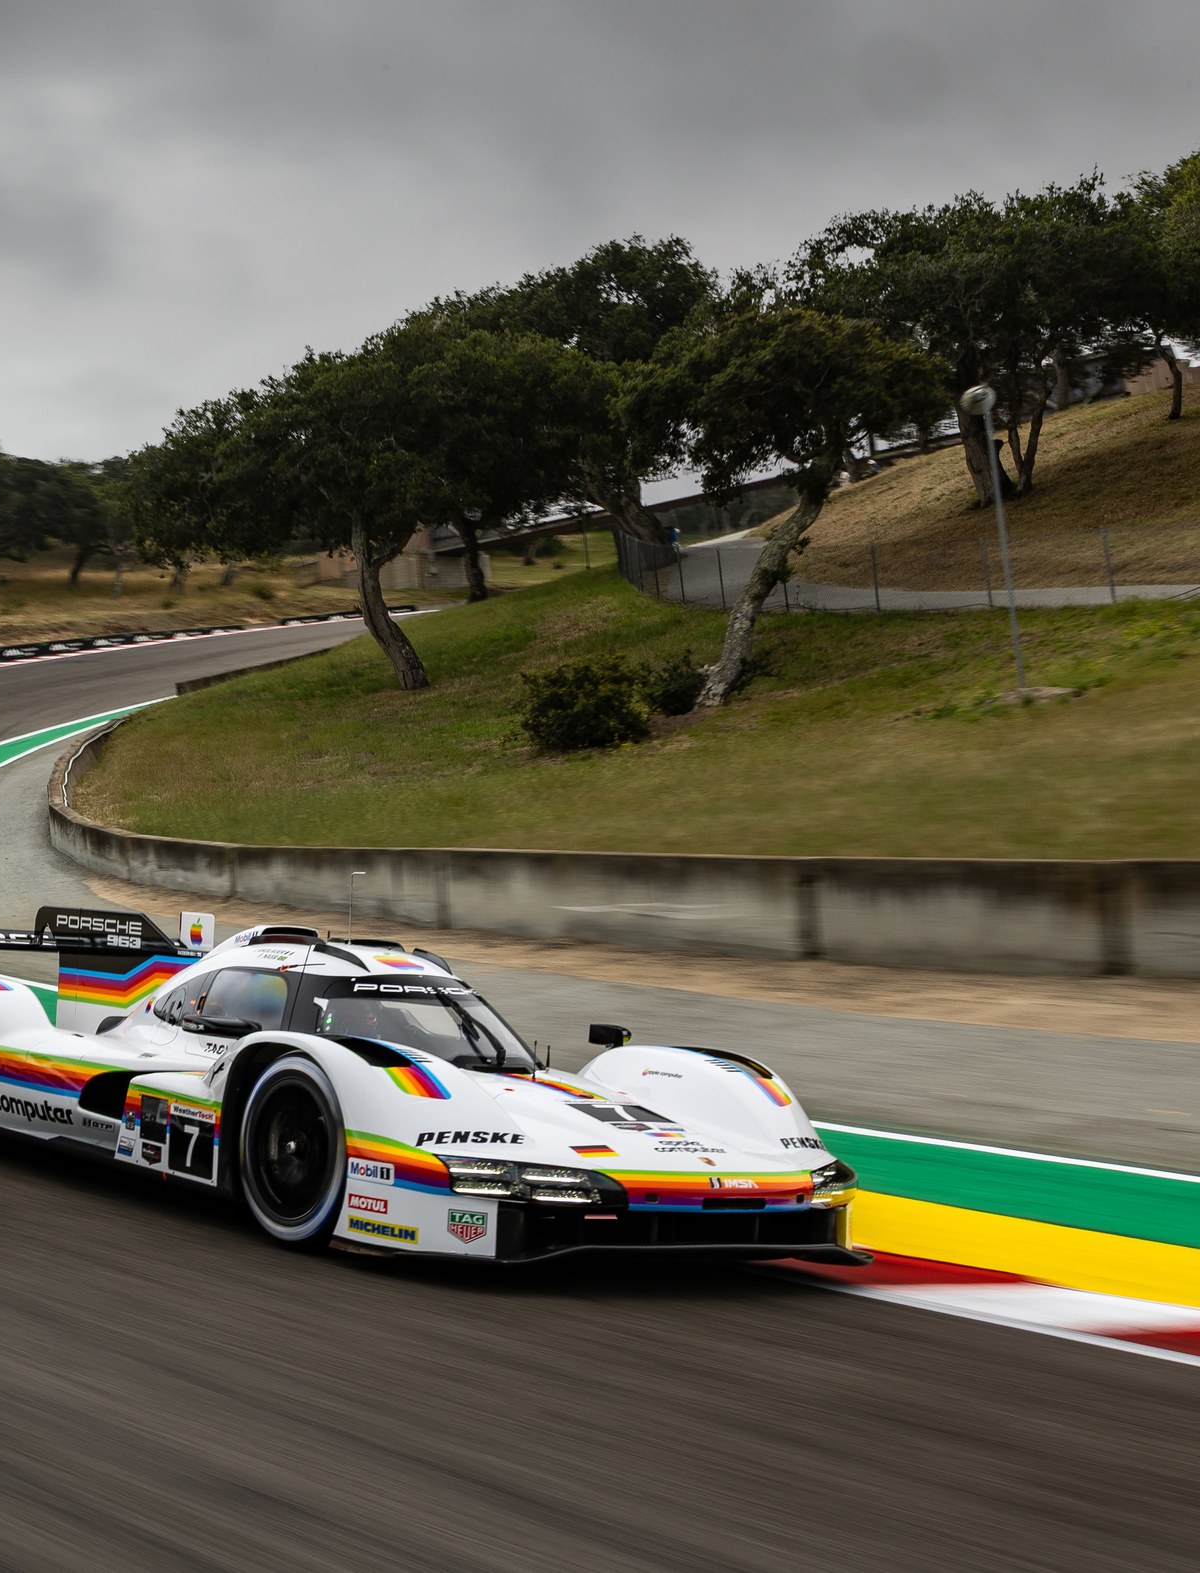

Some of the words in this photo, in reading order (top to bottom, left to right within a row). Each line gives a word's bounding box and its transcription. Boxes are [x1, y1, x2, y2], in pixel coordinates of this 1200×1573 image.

[56, 915, 142, 935] PORSCHE
[107, 934, 141, 949] 963
[173, 1105, 214, 1121] WeatherTech
[184, 1124, 200, 1168] 7
[416, 1131, 525, 1147] PENSKE
[350, 1162, 379, 1179] Mobil
[380, 1166, 390, 1180] 1
[724, 1178, 760, 1189] IMSA
[350, 1195, 387, 1213] MOTUL
[452, 1212, 484, 1225] TAG
[349, 1218, 417, 1241] MICHELIN
[450, 1223, 485, 1240] HEUER
